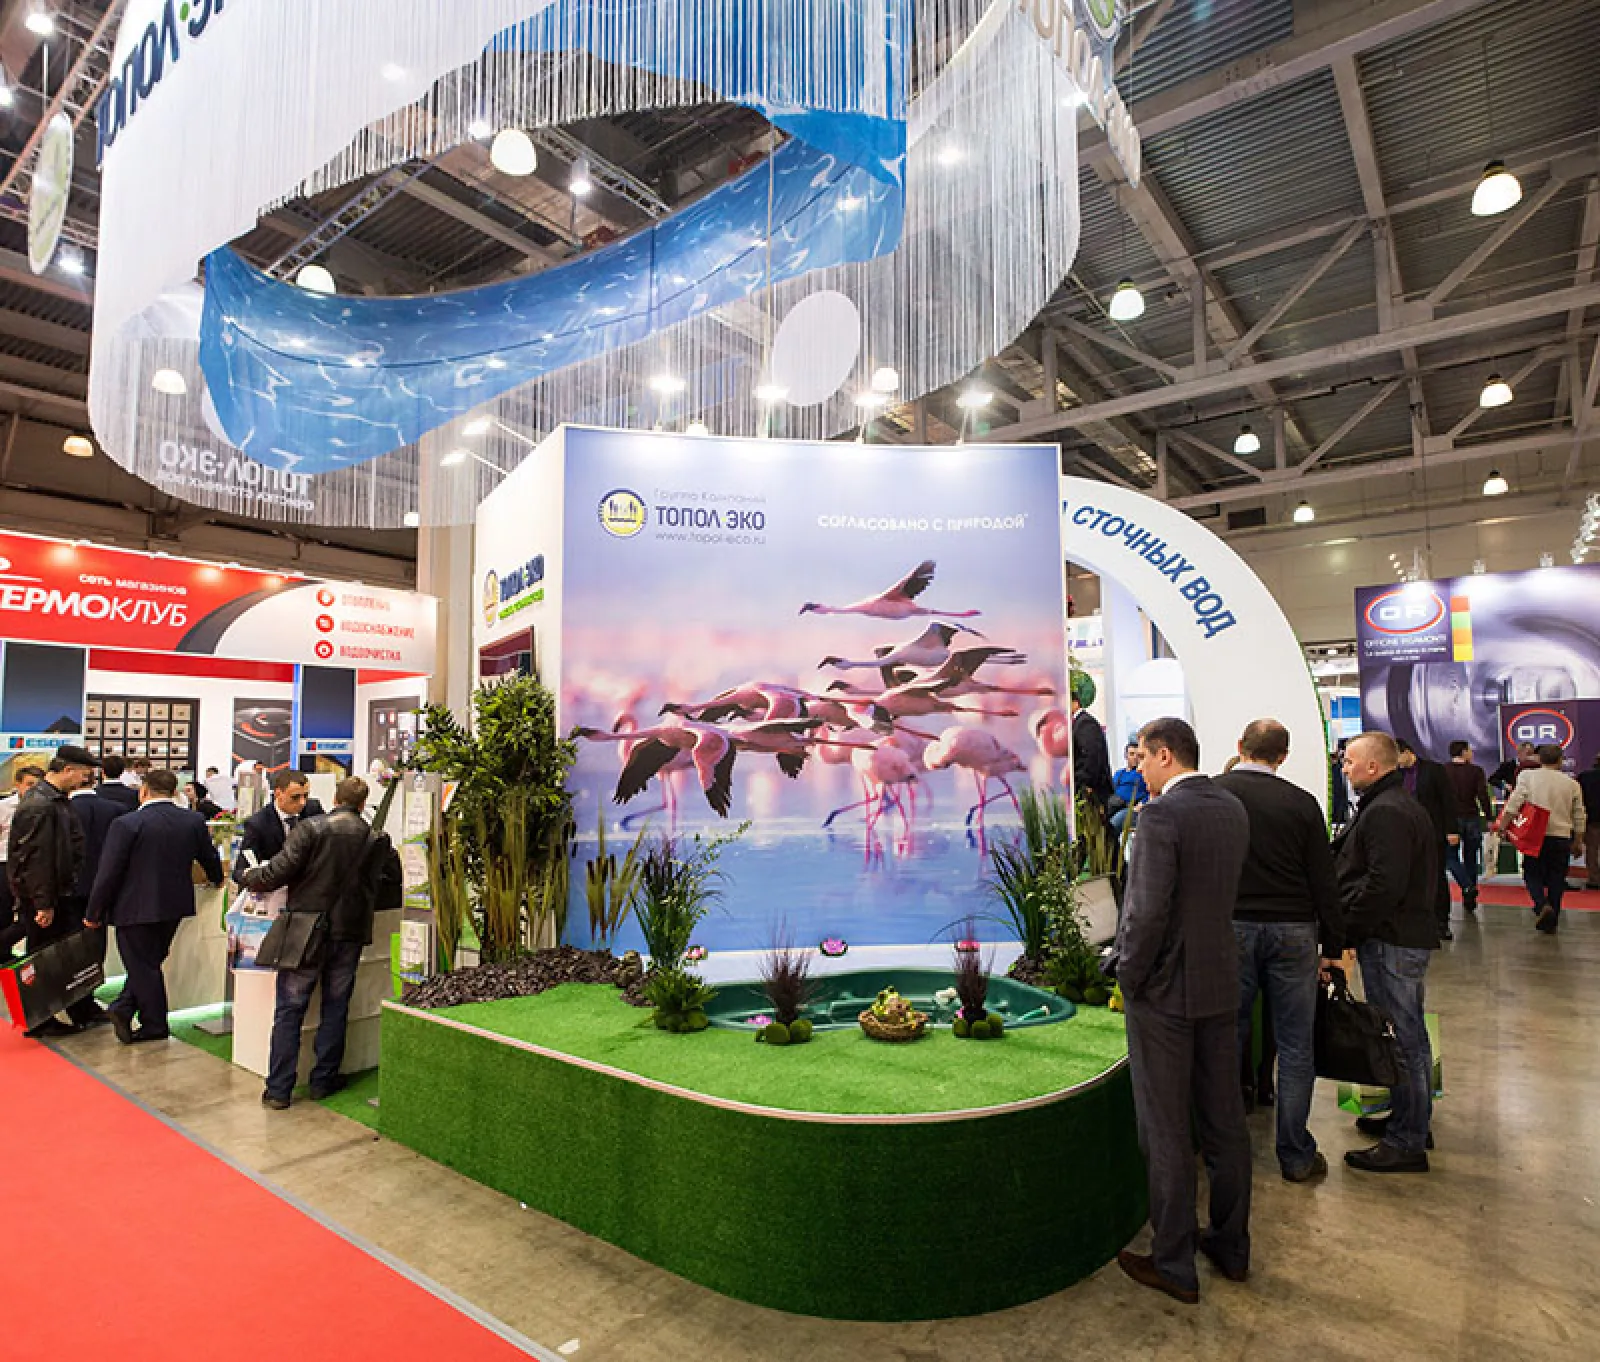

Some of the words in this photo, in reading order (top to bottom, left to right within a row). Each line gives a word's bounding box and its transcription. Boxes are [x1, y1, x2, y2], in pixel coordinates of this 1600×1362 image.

[79, 573, 112, 586] сеть
[115, 577, 187, 596] магазинов
[1072, 505, 1195, 583] СТОЧНЫХ
[1179, 575, 1236, 639] ВОД
[0, 583, 188, 627] ЕРМОКЛУБ
[1517, 725, 1557, 738] OR
